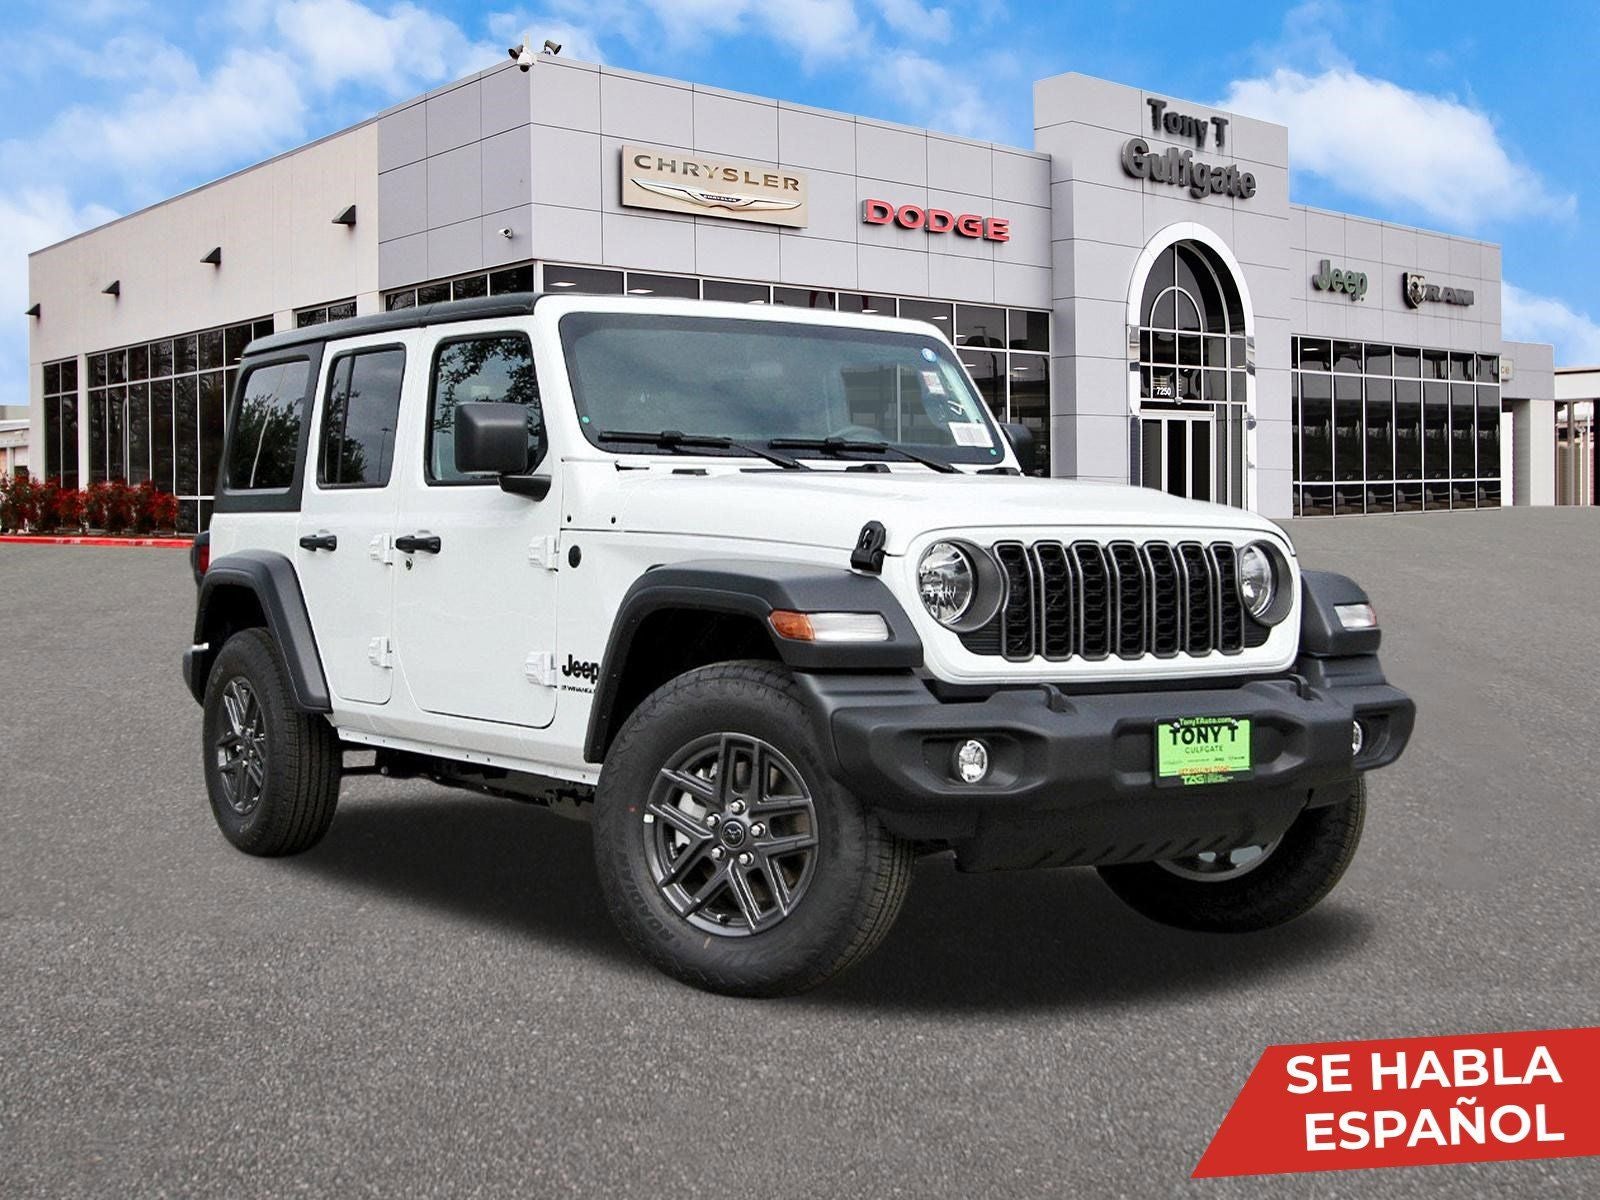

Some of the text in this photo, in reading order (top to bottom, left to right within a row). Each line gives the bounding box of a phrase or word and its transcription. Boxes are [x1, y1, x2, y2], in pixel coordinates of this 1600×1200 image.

[1147, 98, 1229, 147] Tony T
[633, 153, 800, 192] CHRYSLER
[1121, 137, 1256, 199] Gulfgate
[862, 198, 1011, 242] DODGE
[1313, 259, 1368, 301] Jeep
[1424, 284, 1475, 307] RAM
[1156, 387, 1171, 395] 7250
[562, 653, 599, 685] Jeep
[1169, 723, 1239, 746] TONY T
[1185, 746, 1223, 754] GULFGATE
